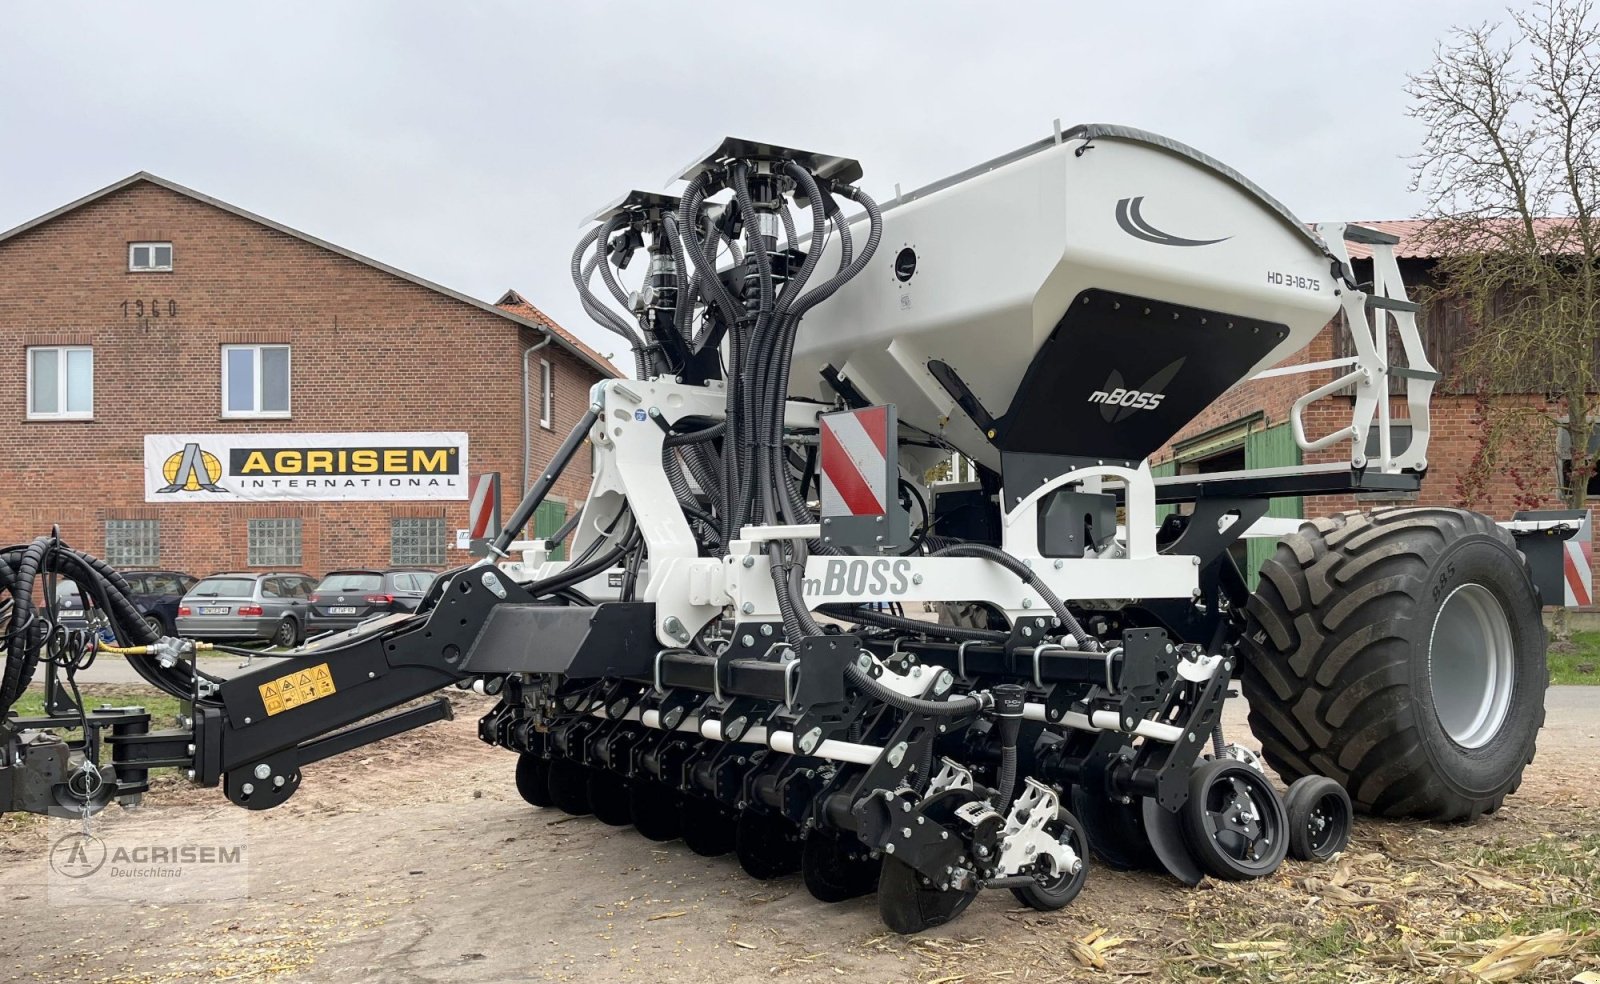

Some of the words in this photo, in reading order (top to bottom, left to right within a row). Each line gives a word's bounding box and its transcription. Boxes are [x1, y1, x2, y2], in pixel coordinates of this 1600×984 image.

[1267, 271, 1283, 284] HD
[120, 299, 176, 317] 1960
[1087, 388, 1166, 410] mBOSS
[241, 478, 456, 488] INTERNATIONAL
[802, 559, 911, 596] mBOSS
